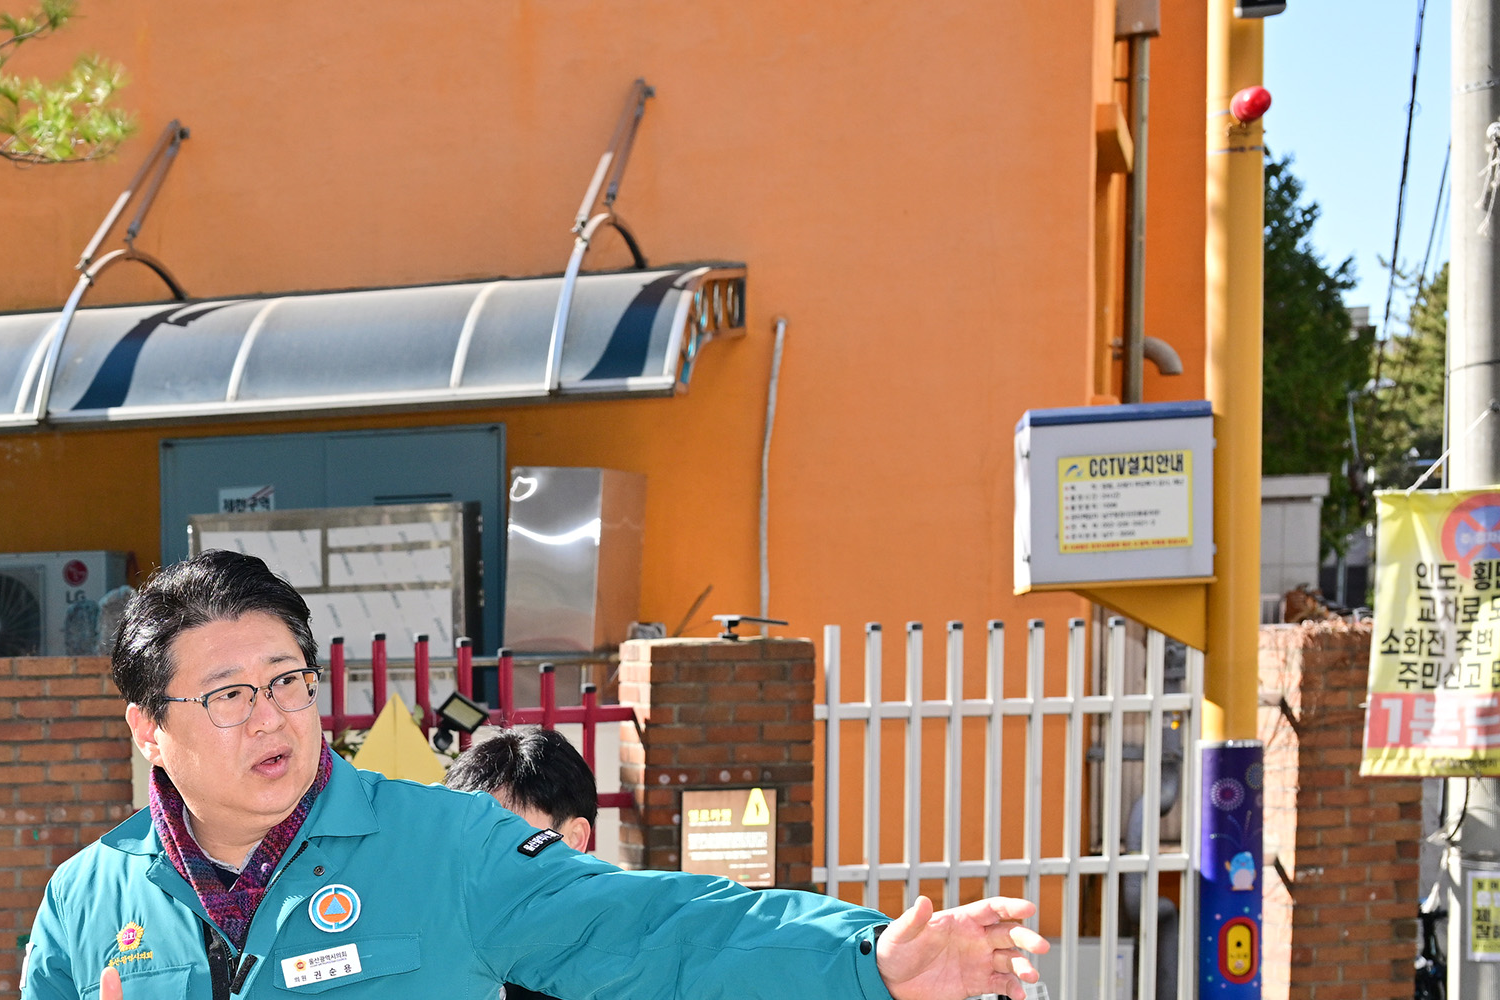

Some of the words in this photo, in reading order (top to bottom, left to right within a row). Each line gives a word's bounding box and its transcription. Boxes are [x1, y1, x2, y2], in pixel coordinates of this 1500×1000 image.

[1089, 453, 1184, 478] CCTV설치안내
[1415, 562, 1463, 593] 인도,
[65, 590, 85, 604] LG
[1417, 596, 1481, 624] 교차로
[1380, 627, 1446, 657] 소화전
[1455, 629, 1493, 656] 주변
[1397, 661, 1482, 690] 주민신고
[108, 950, 153, 967] 울산광역시의회
[308, 951, 348, 965] 울산광역시의회
